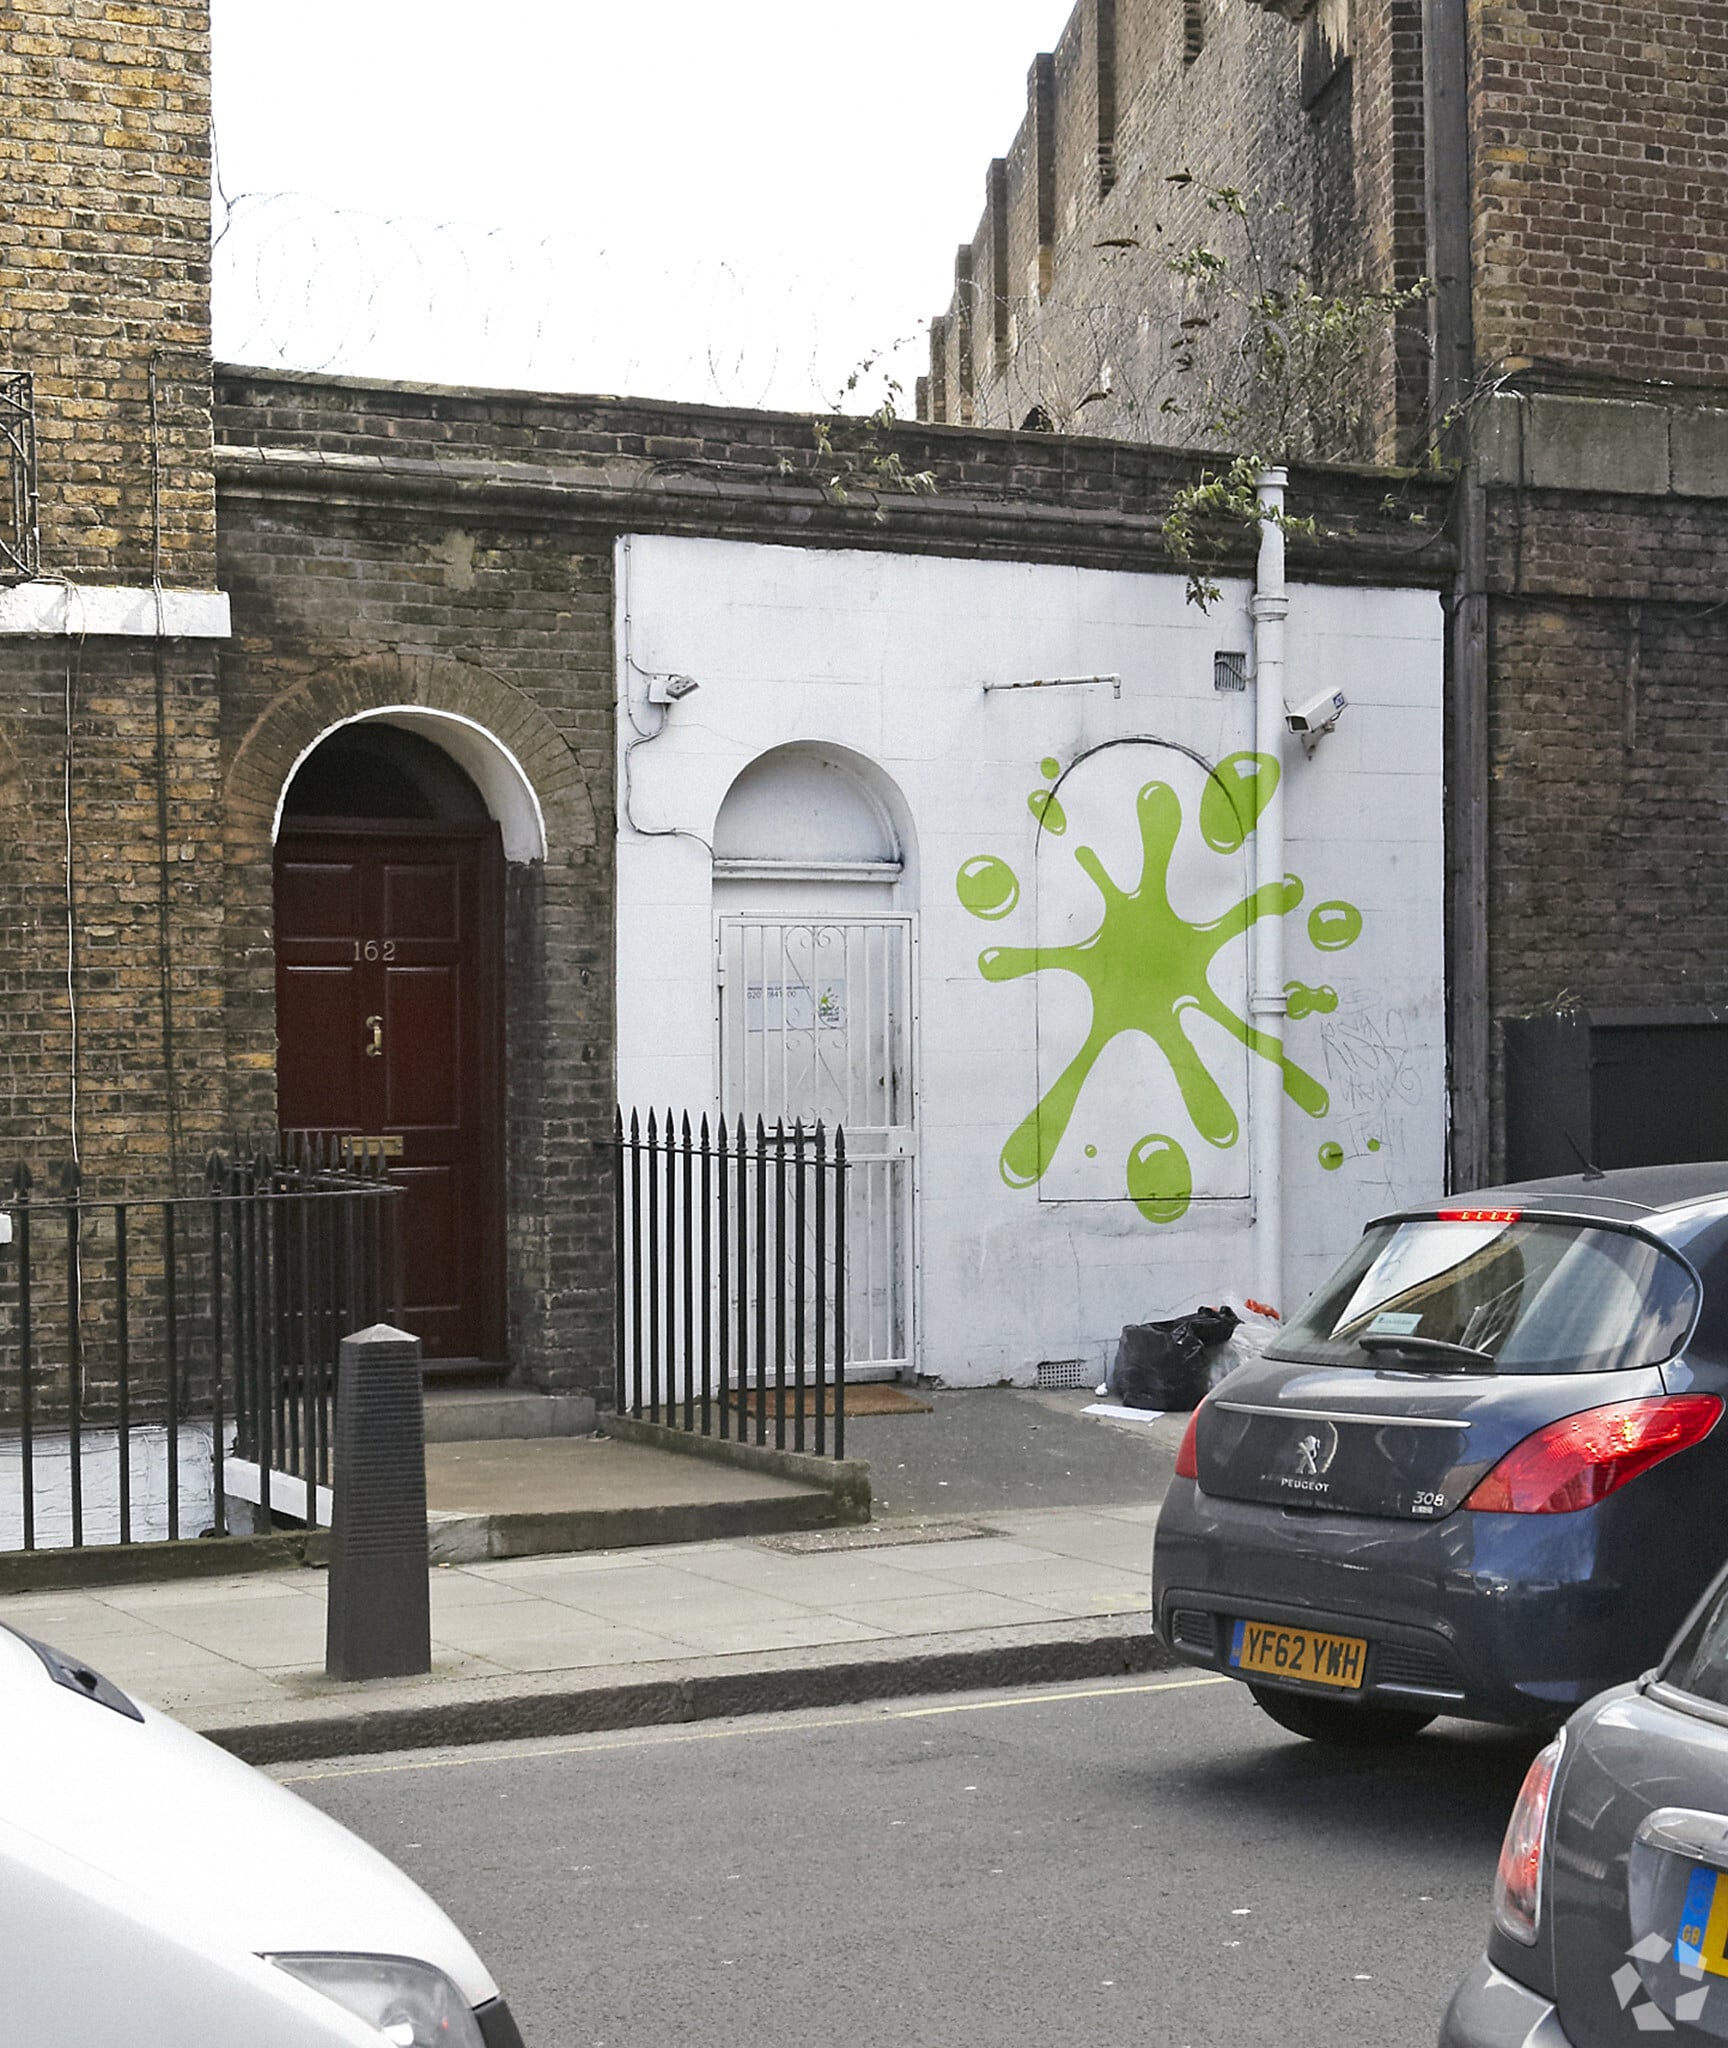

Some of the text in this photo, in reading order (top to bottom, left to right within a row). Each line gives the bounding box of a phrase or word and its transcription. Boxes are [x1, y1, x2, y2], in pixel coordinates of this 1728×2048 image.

[353, 940, 396, 961] 162
[1280, 1477, 1330, 1493] PEUGEOT
[1412, 1491, 1445, 1507] 308
[1249, 1627, 1361, 1681] YF62 YWH
[1682, 1924, 1701, 1946] GB
